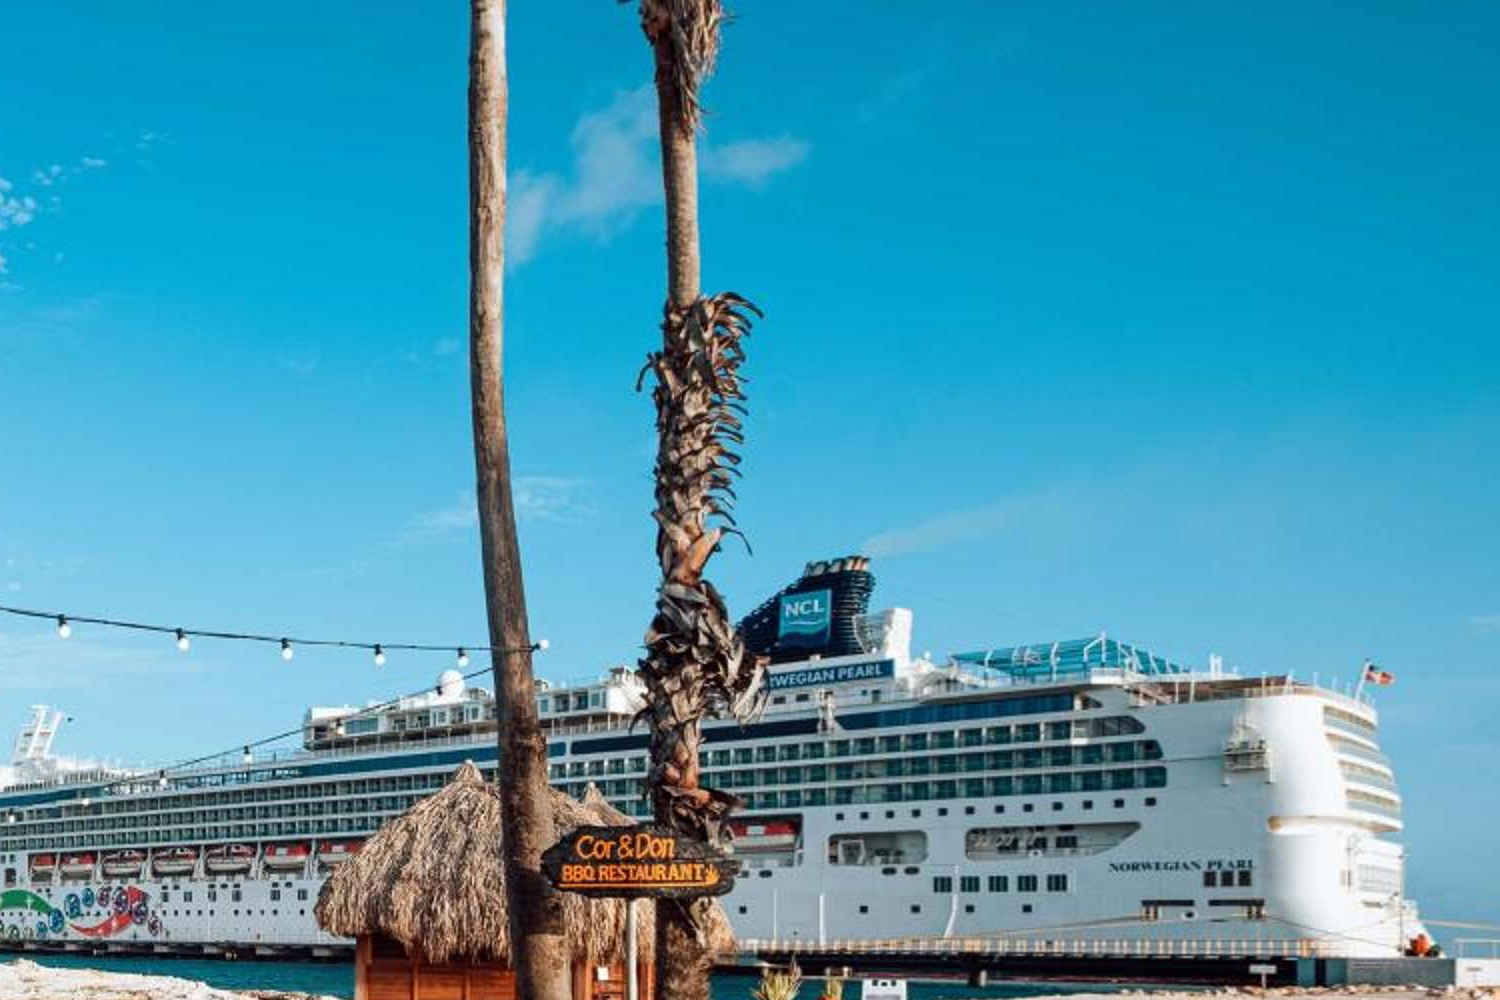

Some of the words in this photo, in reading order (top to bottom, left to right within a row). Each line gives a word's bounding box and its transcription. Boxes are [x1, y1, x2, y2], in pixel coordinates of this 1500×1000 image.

[785, 600, 826, 617] NCL
[837, 664, 884, 680] PEARL
[576, 835, 616, 859] Cor
[618, 834, 634, 858] &
[635, 833, 676, 859] Don
[562, 864, 596, 882] BBQ
[599, 863, 705, 881] RESTAURANT
[1109, 860, 1202, 873] NORWEGIAN
[1206, 859, 1254, 871] PEARL
